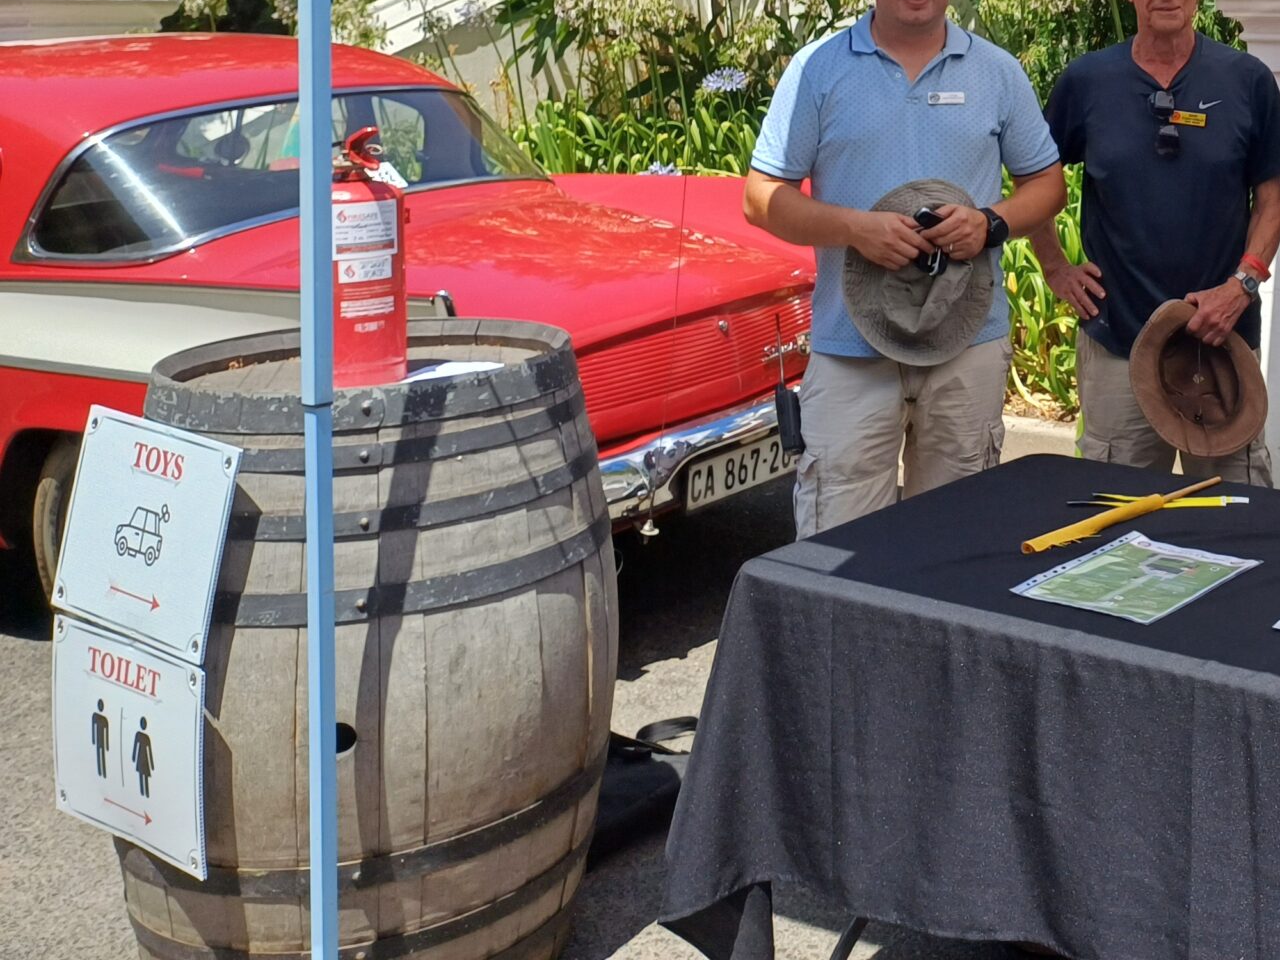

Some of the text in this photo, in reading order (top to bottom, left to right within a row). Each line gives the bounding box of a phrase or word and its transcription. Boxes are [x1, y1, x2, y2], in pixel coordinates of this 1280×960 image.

[133, 441, 185, 481] TOYS
[691, 464, 715, 503] CA
[88, 646, 161, 697] TOILET
